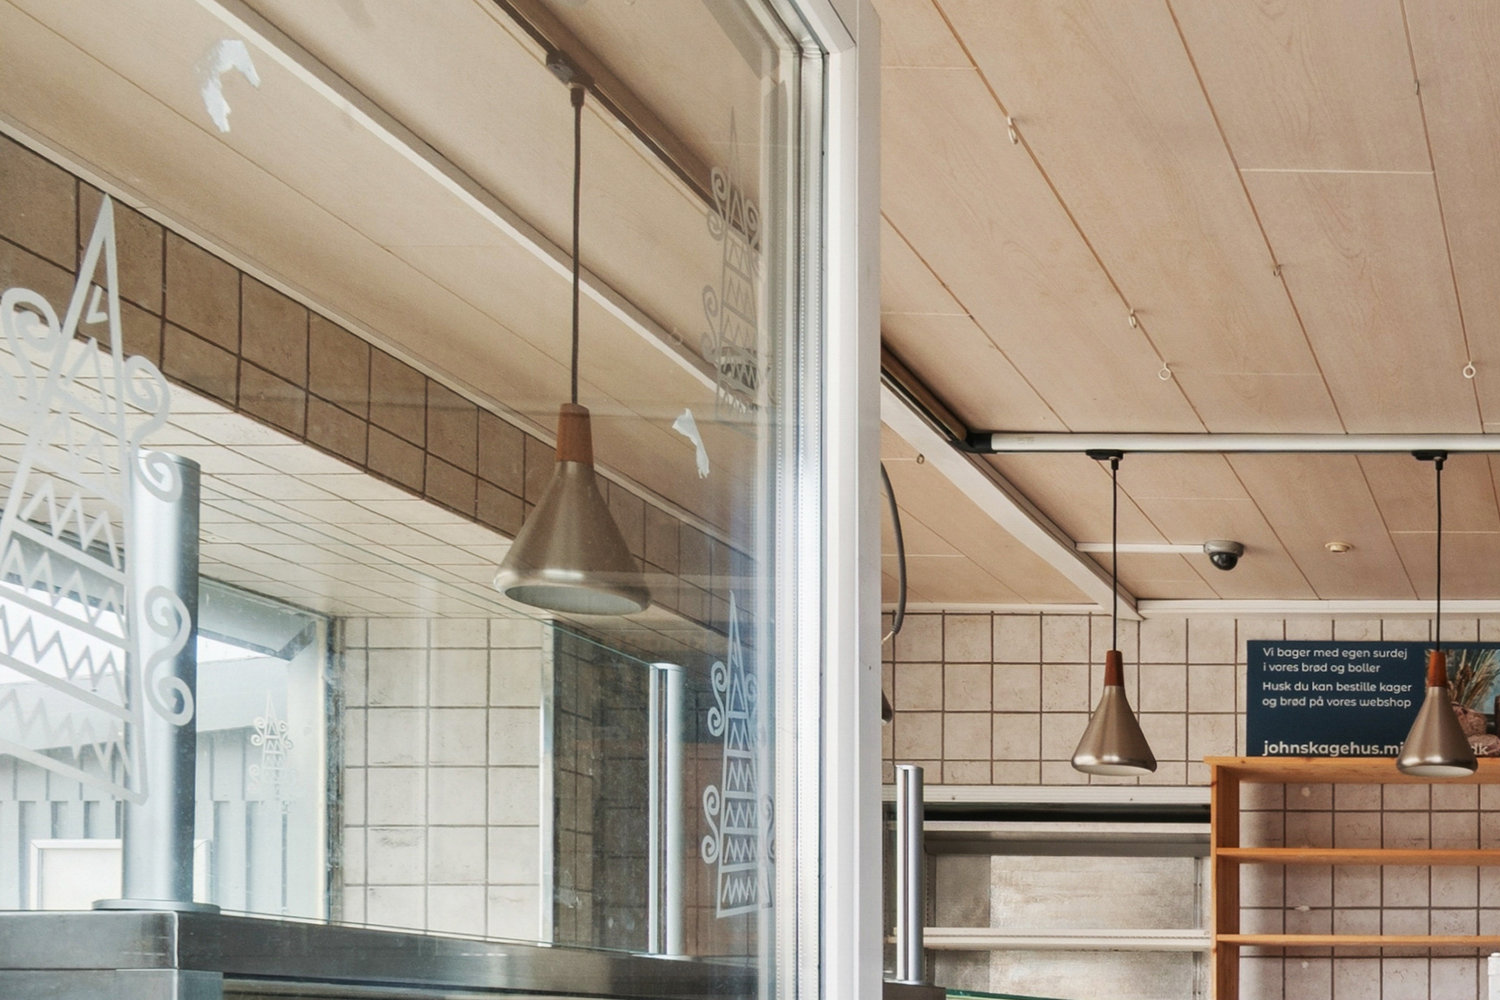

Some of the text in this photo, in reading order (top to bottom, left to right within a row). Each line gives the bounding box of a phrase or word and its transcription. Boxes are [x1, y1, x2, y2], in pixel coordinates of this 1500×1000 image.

[1263, 647, 1408, 660] Vi bager med egen surdej
[1268, 664, 1299, 672] vores
[1301, 662, 1328, 672] brød
[1330, 664, 1345, 675] og
[1348, 663, 1381, 673] boller
[1262, 681, 1412, 694] Husk du kan bestille kager
[1262, 696, 1412, 709] og brød på vores webshop
